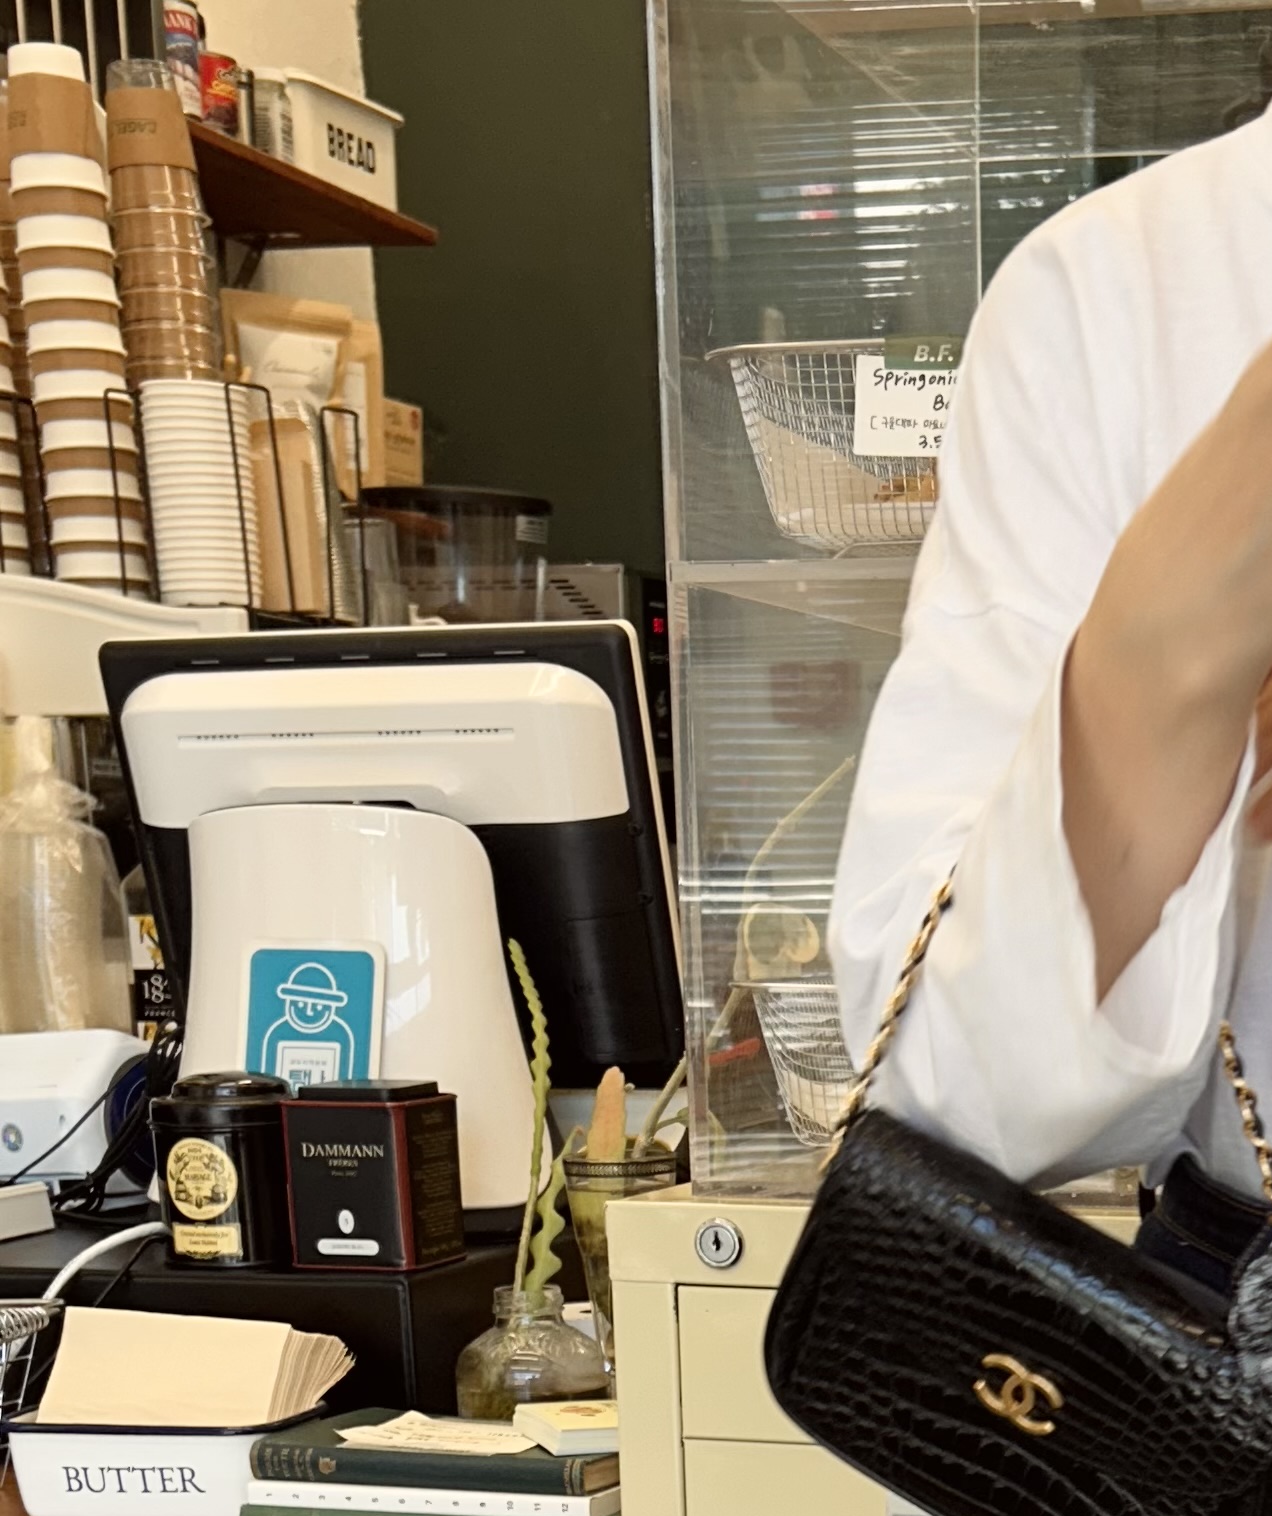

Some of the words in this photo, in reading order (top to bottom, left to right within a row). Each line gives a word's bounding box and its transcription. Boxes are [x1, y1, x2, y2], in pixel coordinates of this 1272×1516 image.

[327, 122, 376, 174] BREAD
[914, 344, 954, 362] B.F.
[301, 1142, 384, 1158] DAMMANN
[61, 1466, 206, 1493] BUTTER
